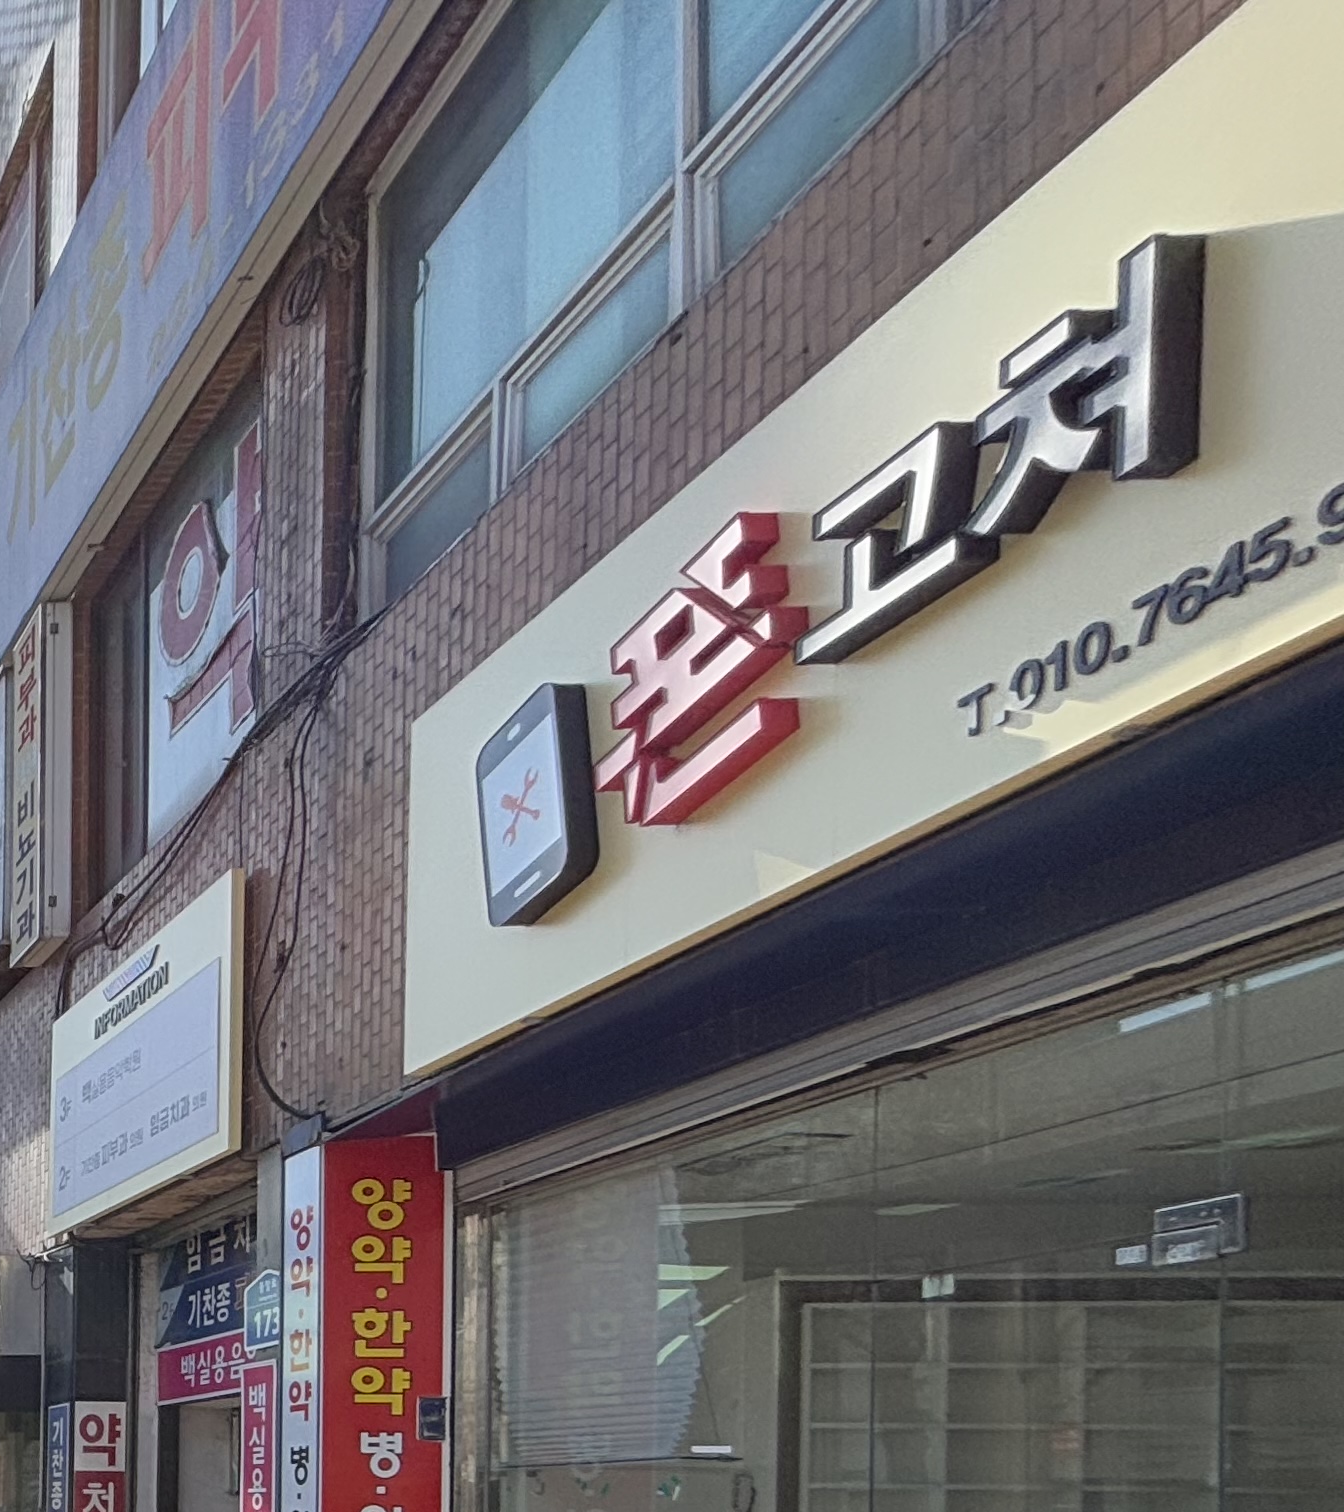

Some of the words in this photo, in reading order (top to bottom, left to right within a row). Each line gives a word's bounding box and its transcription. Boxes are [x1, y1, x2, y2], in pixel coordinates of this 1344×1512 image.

[6, 188, 129, 547] 기찬종
[18, 623, 37, 752] 피부과
[16, 779, 36, 944] 비뇨기과
[94, 961, 169, 1040] INFORMATION
[60, 1096, 72, 1123] 3F
[58, 1166, 71, 1191] 2F
[188, 1282, 231, 1328] 기찬종
[254, 1307, 280, 1339] 173
[50, 1417, 64, 1510] 기찬종
[79, 1413, 121, 1467] 약
